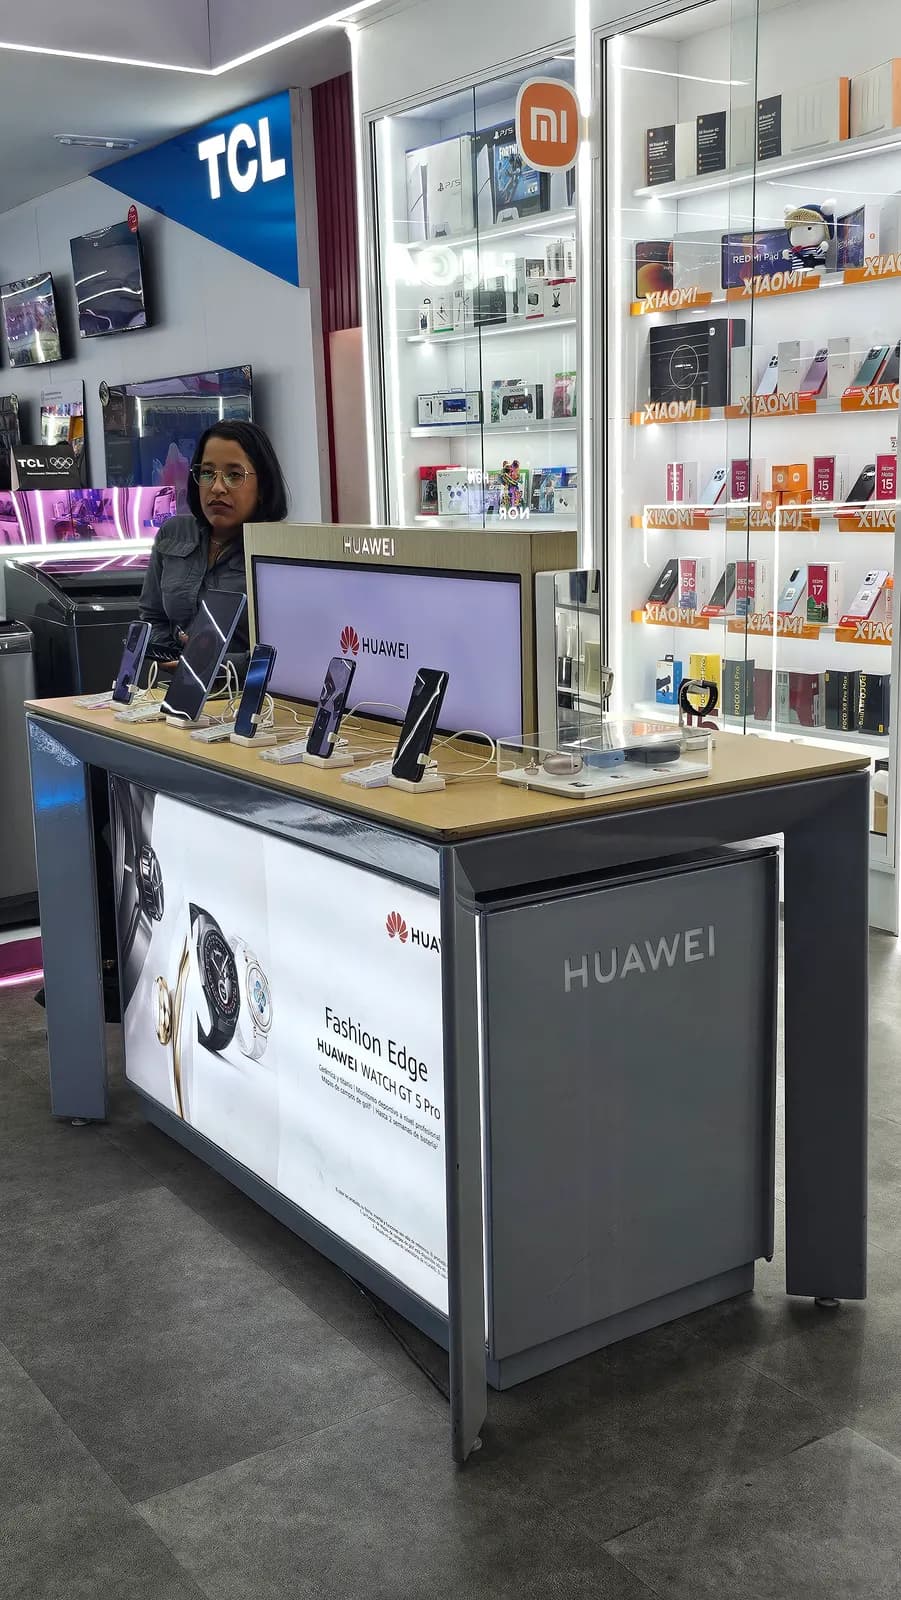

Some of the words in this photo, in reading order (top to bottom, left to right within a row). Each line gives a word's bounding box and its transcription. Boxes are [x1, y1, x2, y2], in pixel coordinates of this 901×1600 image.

[198, 116, 286, 200] TCL
[742, 271, 804, 296] XIAOMI
[645, 287, 698, 310] XIAOMI
[643, 400, 697, 420] XIAOMI
[740, 391, 800, 415] XIAOMI
[17, 459, 45, 468] TCL
[735, 481, 746, 492] 15
[818, 480, 829, 491] 15
[881, 478, 893, 490] 15
[646, 508, 694, 526] XIAOMI
[743, 509, 803, 527] XIAOMI
[343, 536, 395, 556] HUAWEI
[812, 585, 824, 596] 17
[645, 602, 697, 624] XIAOMI
[744, 613, 804, 634] XIAOMI
[362, 637, 409, 660] HUAWEI
[411, 927, 441, 953] HUA
[564, 925, 715, 992] HUAWEI
[325, 1006, 381, 1057] Fashion
[388, 1039, 428, 1082] Edge
[317, 1037, 358, 1072] HUAWEI
[360, 1062, 397, 1096] WATCH
[398, 1085, 413, 1104] GT
[415, 1093, 422, 1109] 5
[424, 1098, 441, 1120] Pro
